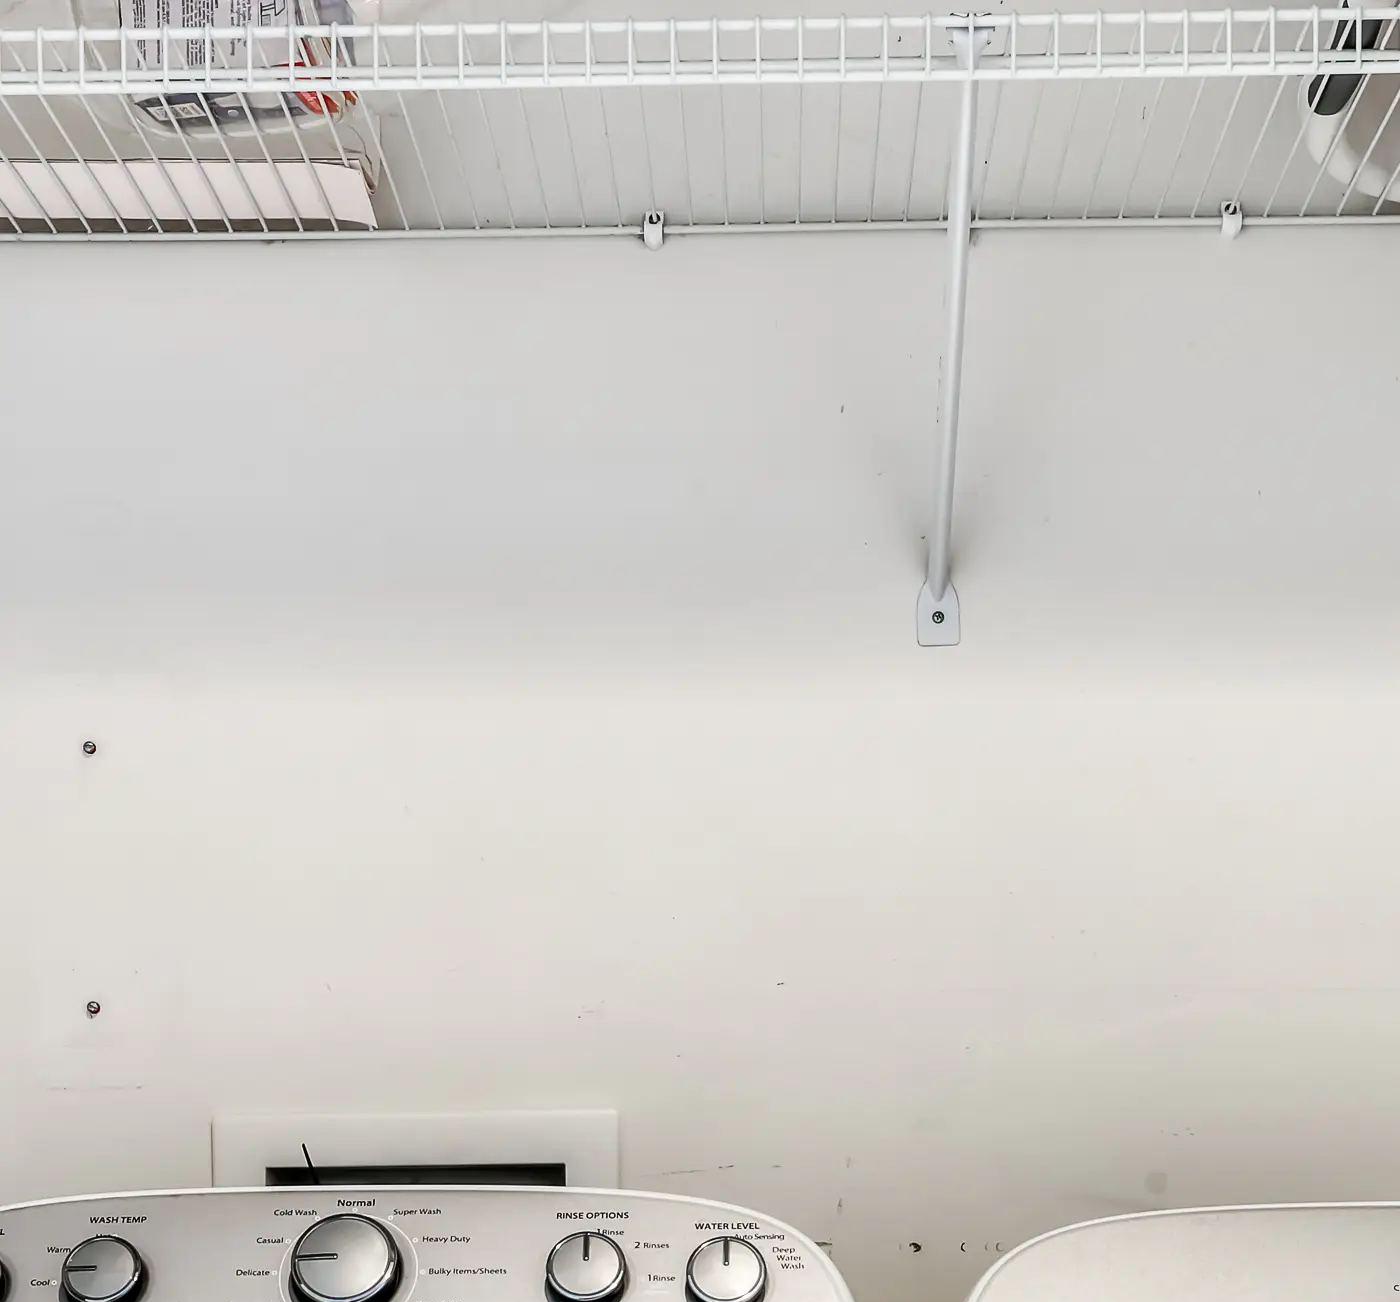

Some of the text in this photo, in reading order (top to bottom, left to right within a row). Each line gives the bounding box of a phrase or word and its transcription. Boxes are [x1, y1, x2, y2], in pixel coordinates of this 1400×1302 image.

[337, 1199, 376, 1207] Normal
[634, 1241, 641, 1249] 2
[428, 1268, 451, 1276] Bulky
